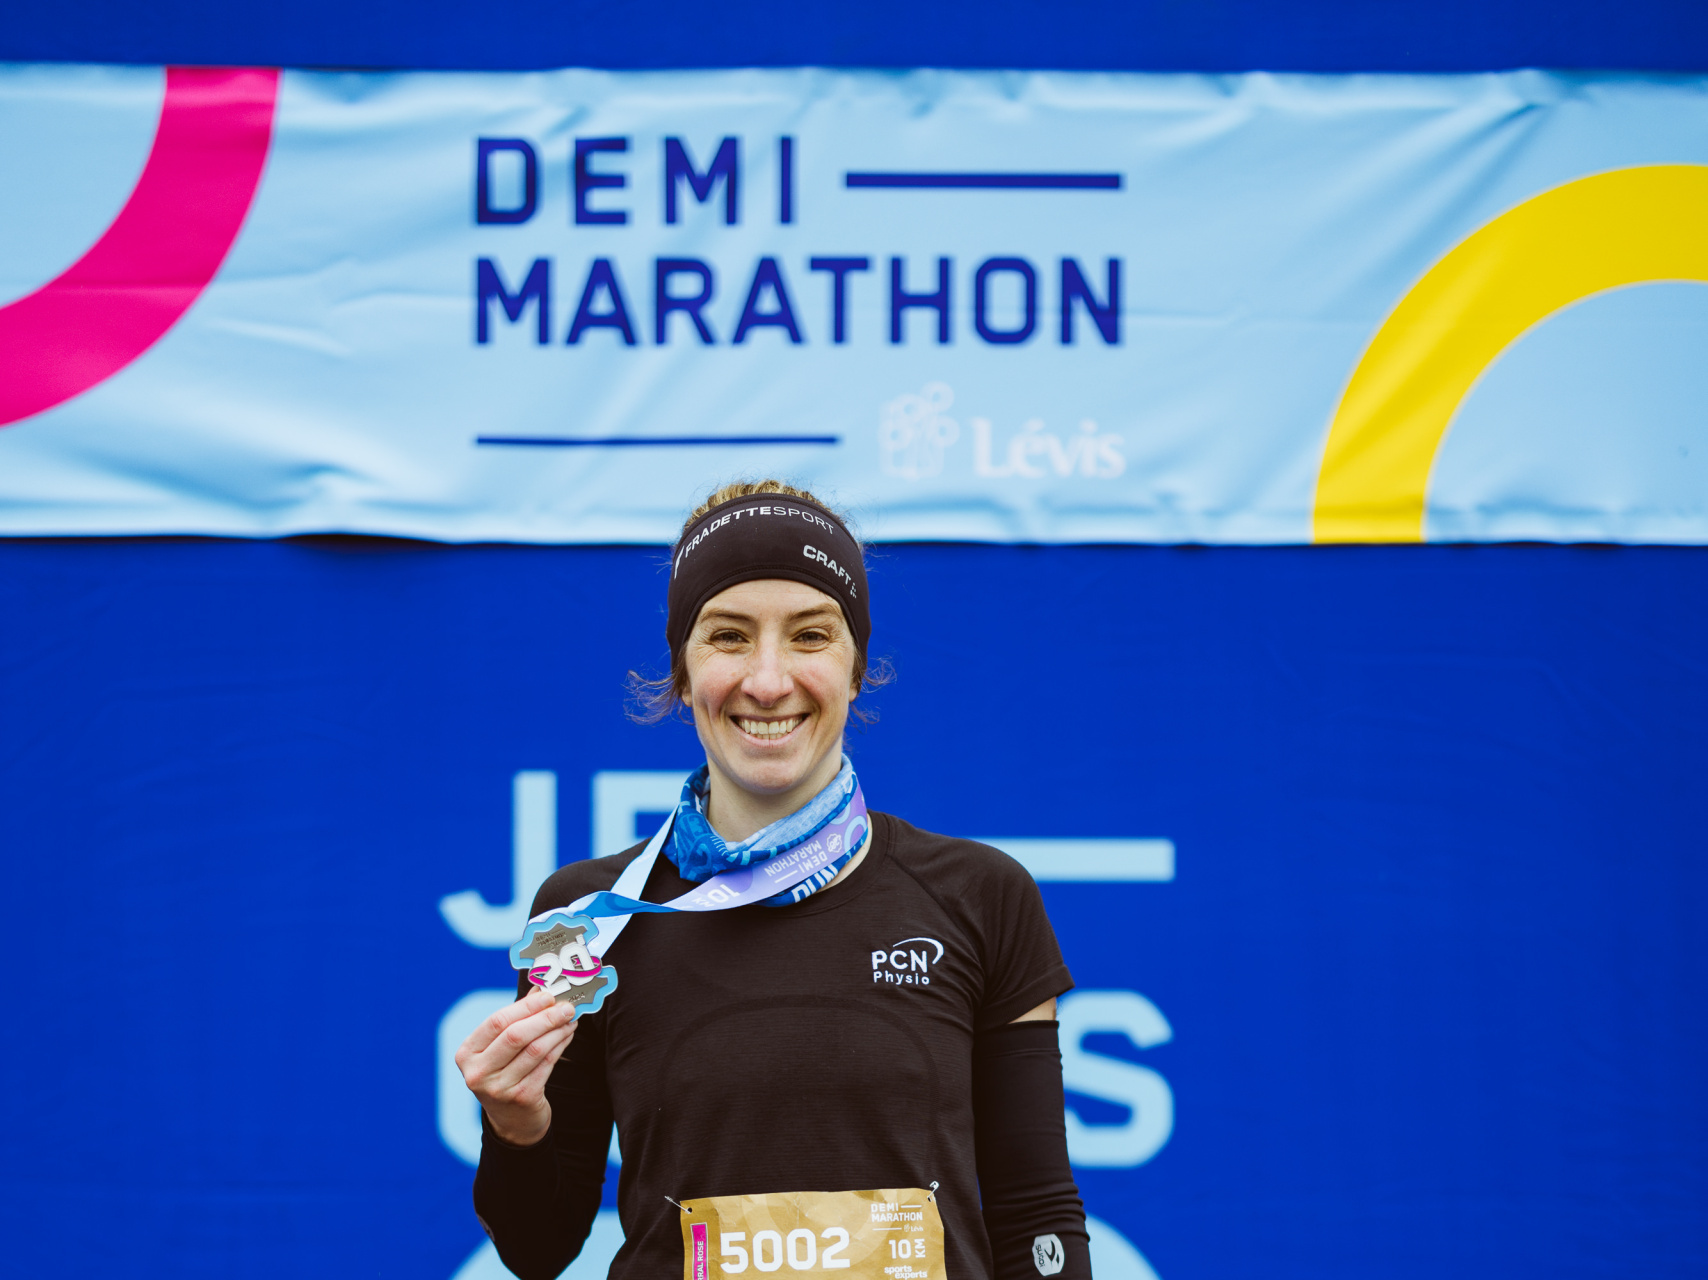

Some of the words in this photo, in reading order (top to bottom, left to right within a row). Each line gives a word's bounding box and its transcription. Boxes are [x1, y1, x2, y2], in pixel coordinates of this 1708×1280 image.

[476, 136, 794, 226] DEMI
[476, 257, 1121, 345] MARATHON
[970, 417, 1127, 479] Lévis
[803, 544, 852, 586] CRAFT
[764, 840, 822, 877] MARATHON
[798, 850, 828, 874] DEMI
[707, 883, 741, 903] 10
[871, 949, 928, 973] PCN
[873, 970, 930, 985] Physio
[871, 1203, 899, 1212] DEMI
[872, 1212, 923, 1222] MARATHON
[720, 1227, 851, 1274] 5002
[888, 1239, 911, 1259] 10
[914, 1238, 926, 1258] KM
[884, 1265, 912, 1275] sports
[894, 1270, 928, 1280] experts
